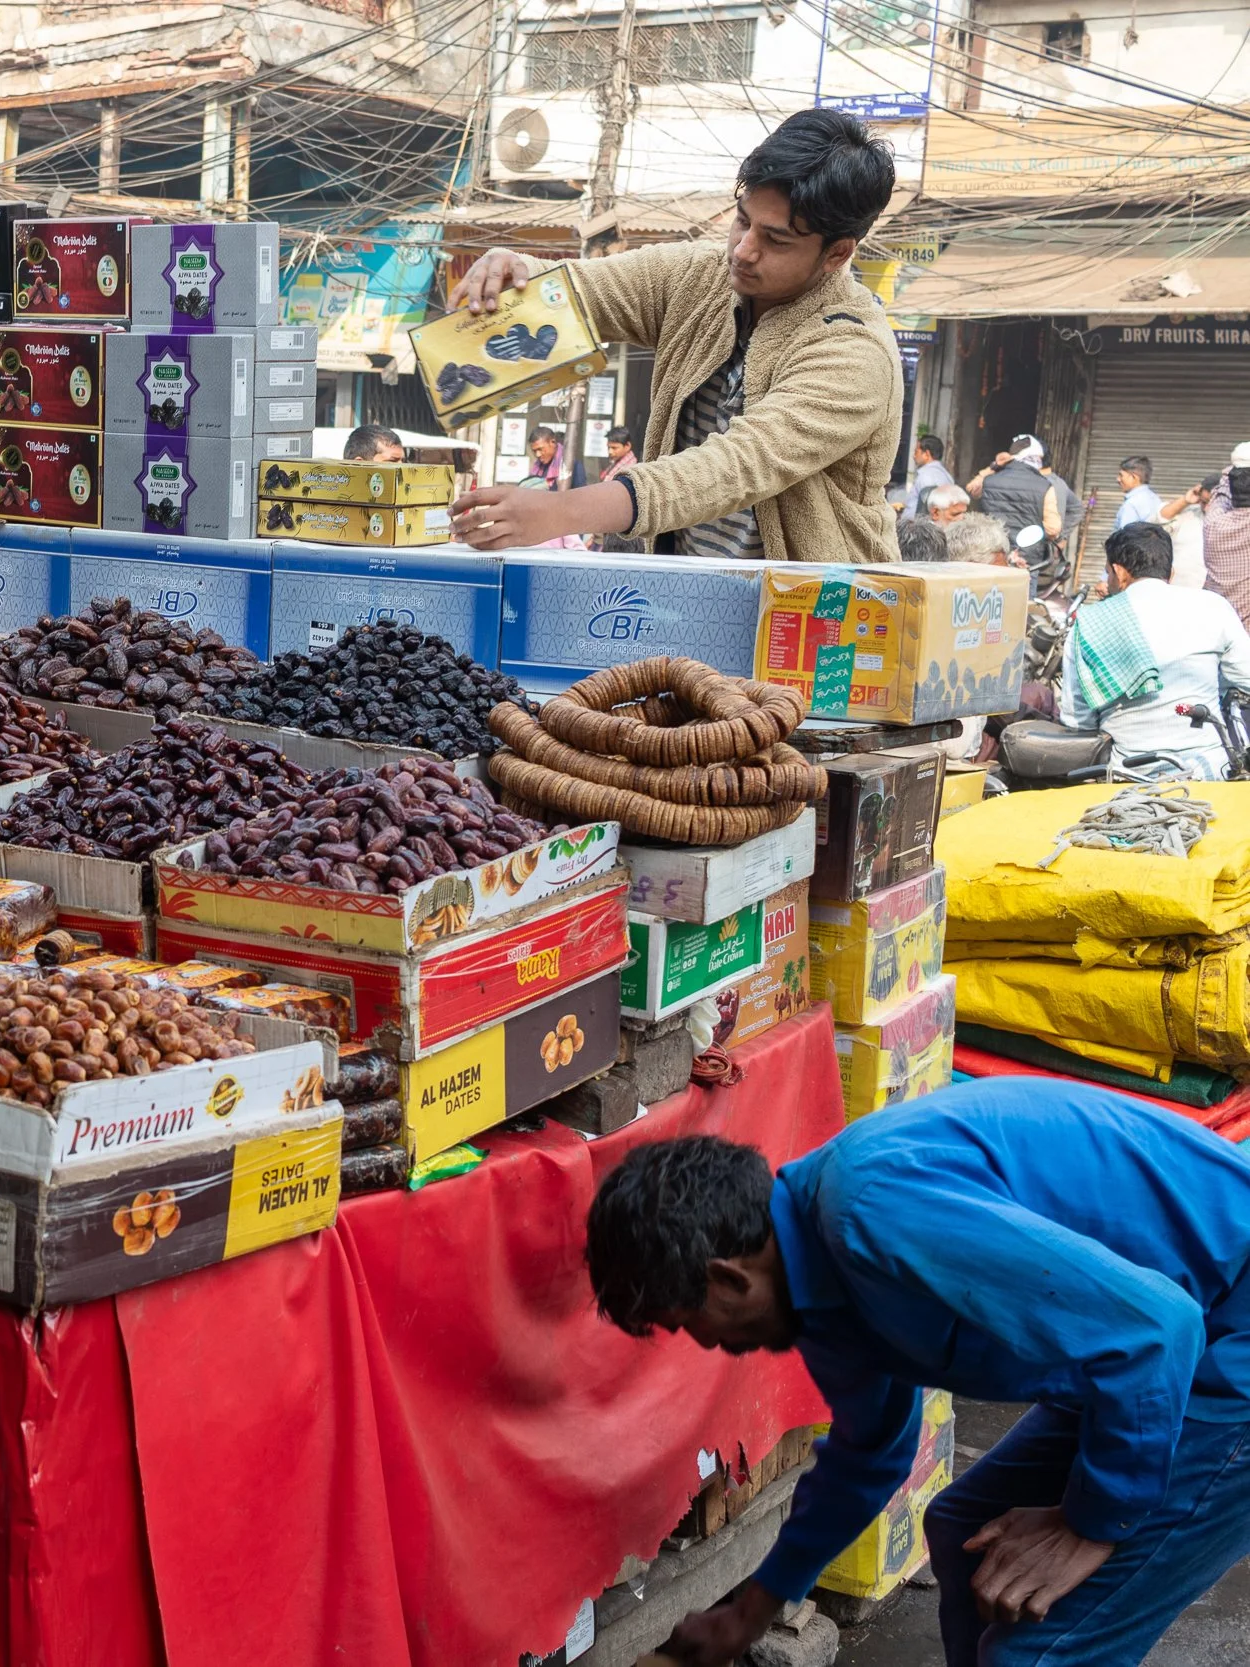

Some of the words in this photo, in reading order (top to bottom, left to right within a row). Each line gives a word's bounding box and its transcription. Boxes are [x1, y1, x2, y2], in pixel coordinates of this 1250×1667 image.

[931, 159, 974, 173] Whole
[149, 589, 198, 616] CBF+
[338, 590, 353, 602] plus
[953, 589, 1003, 624] Kimia
[588, 608, 655, 642] CBF+
[578, 640, 610, 653] Cap-bon
[658, 646, 676, 656] plus
[507, 943, 532, 962] dates
[517, 947, 560, 986] Rama
[708, 957, 723, 973] Date
[723, 948, 745, 966] Crown
[421, 1085, 436, 1109] AL
[439, 1063, 481, 1100] HAJEM
[445, 1086, 481, 1116] DATES
[68, 1103, 194, 1155] Premium
[262, 1162, 304, 1188] DATES
[258, 1181, 309, 1214] HAJEM
[314, 1174, 331, 1197] AL
